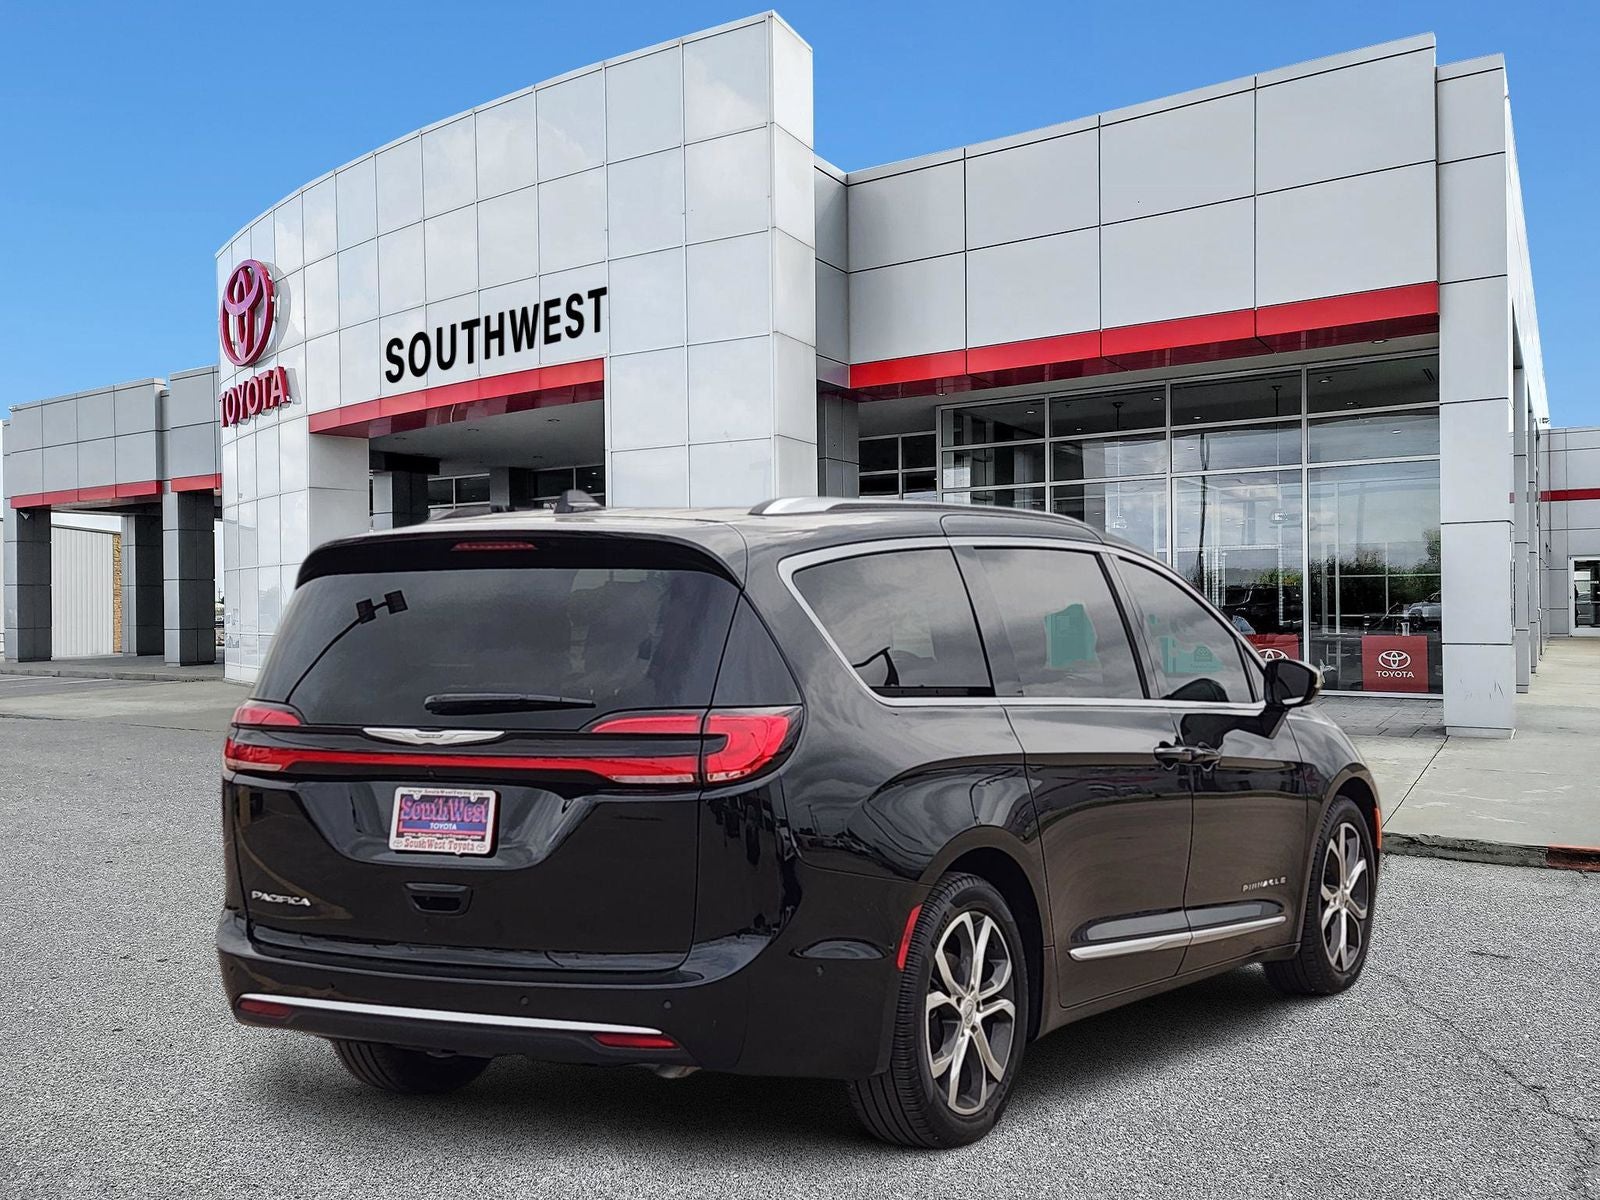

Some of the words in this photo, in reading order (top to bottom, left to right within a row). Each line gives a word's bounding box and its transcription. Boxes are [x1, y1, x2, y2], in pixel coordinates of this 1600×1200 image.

[384, 286, 608, 384] SOUTHWEST
[219, 366, 291, 427] TOYOTA
[1375, 669, 1415, 679] TOYOTA
[429, 822, 457, 831] TOYOTA
[447, 840, 475, 852] Toyota
[251, 890, 311, 907] PACIFICA
